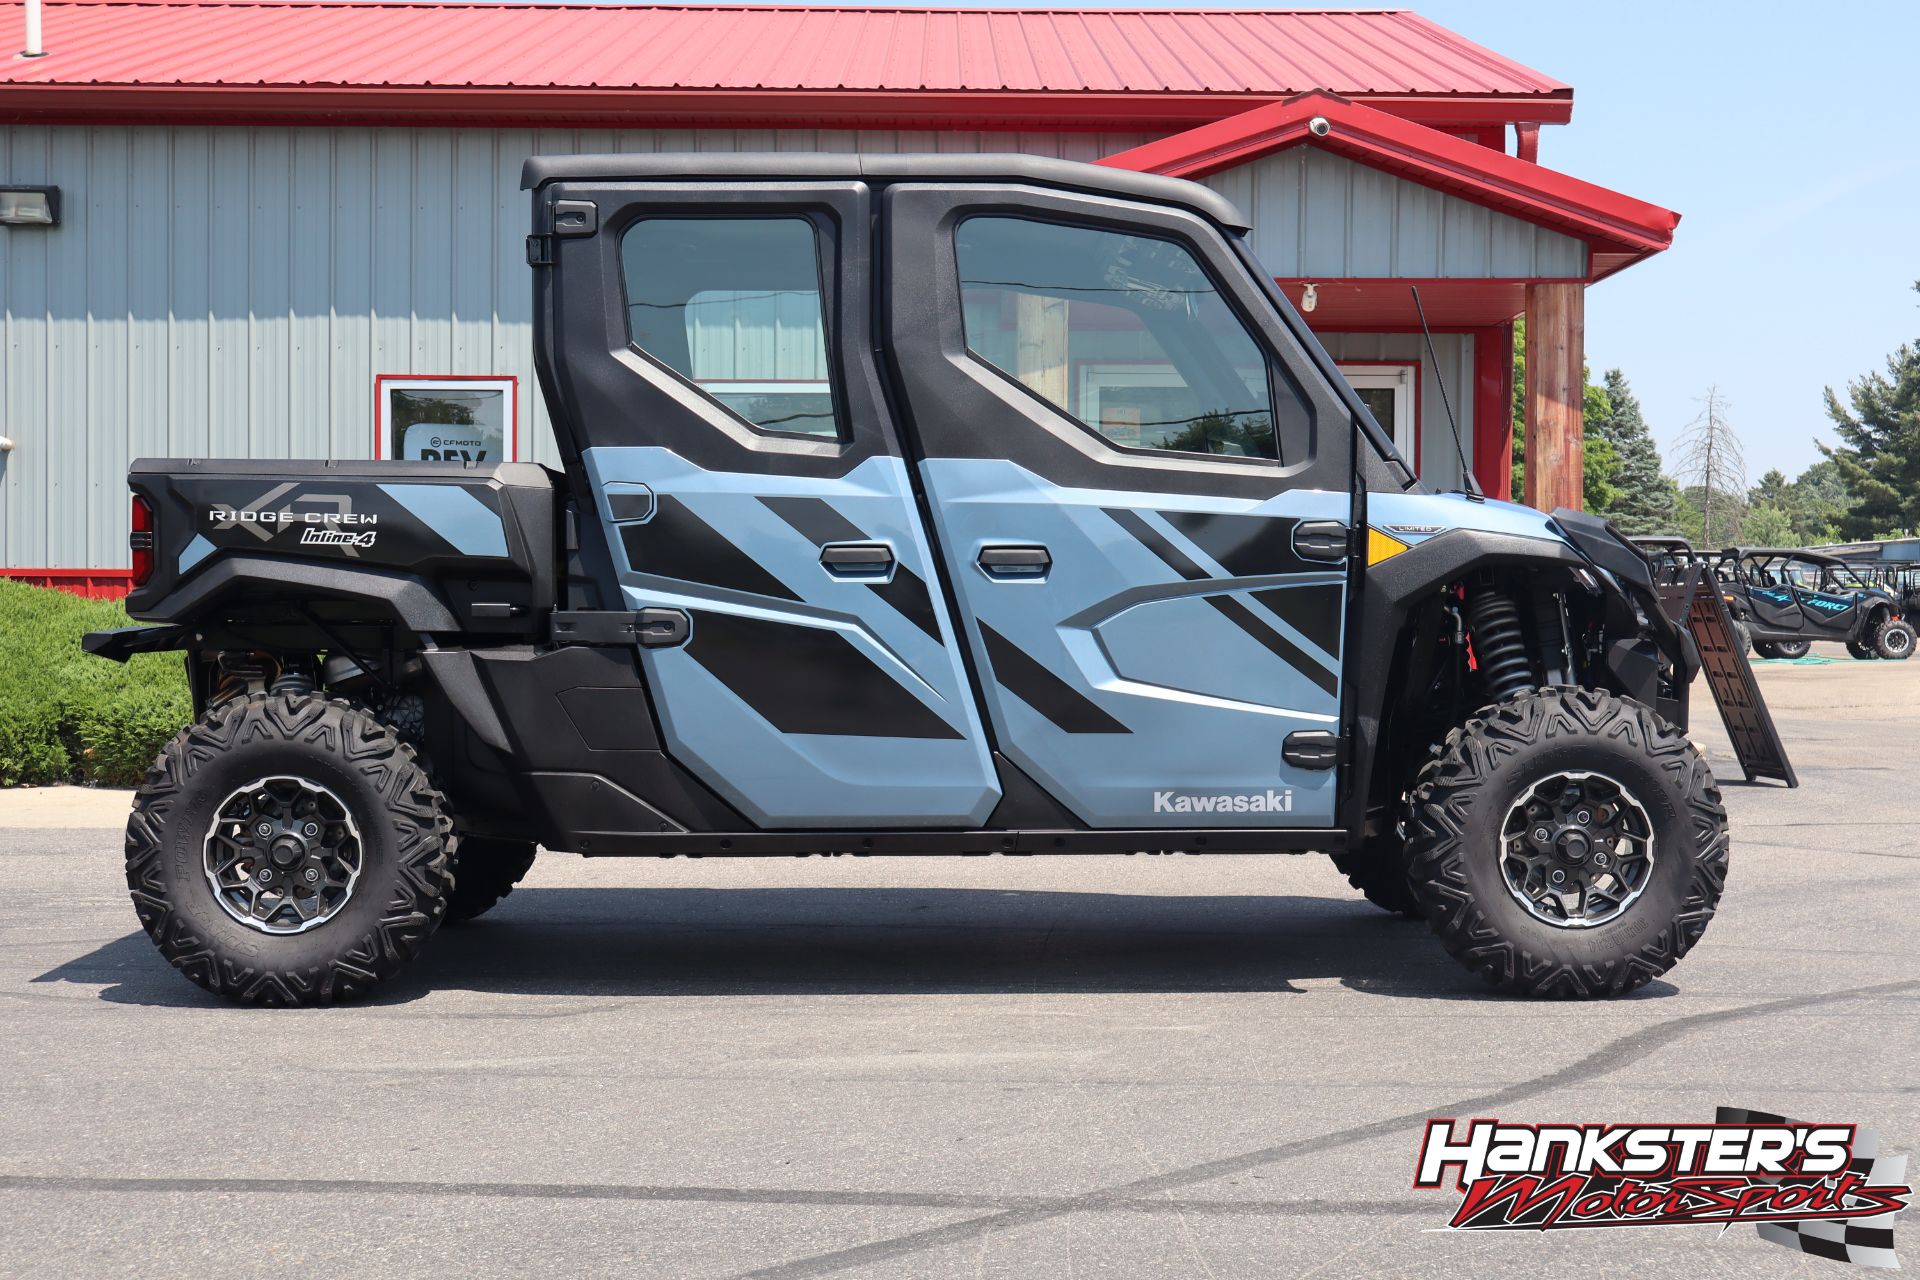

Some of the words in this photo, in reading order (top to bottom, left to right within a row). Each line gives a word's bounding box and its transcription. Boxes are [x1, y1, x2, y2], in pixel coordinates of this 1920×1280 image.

[209, 510, 294, 523] RIDGE
[304, 512, 378, 525] CREW
[300, 528, 377, 547] Inline-4
[1153, 790, 1292, 813] Kawasaki
